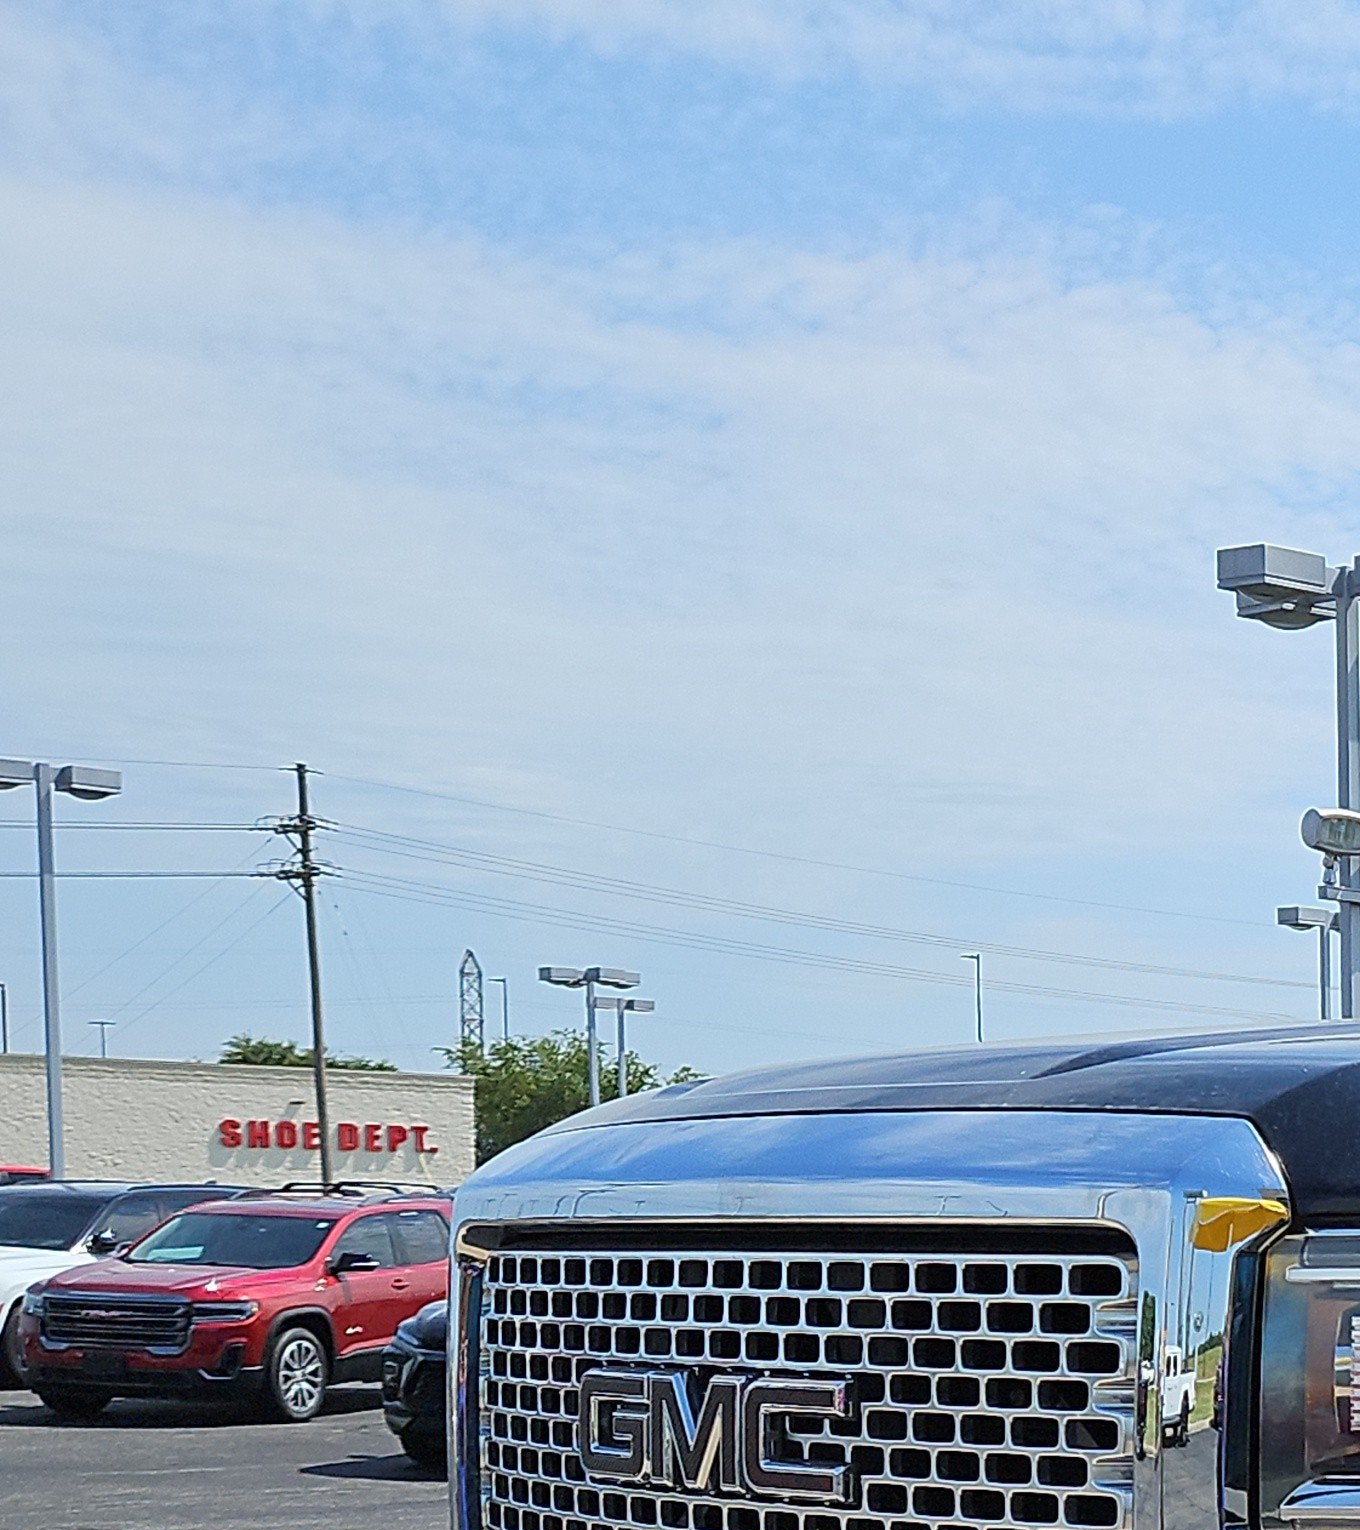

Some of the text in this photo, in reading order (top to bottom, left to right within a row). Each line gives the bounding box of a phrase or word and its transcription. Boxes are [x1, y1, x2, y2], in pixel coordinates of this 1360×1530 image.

[218, 1118, 439, 1153] SHOE DEPT.
[580, 1367, 856, 1502] GMC
